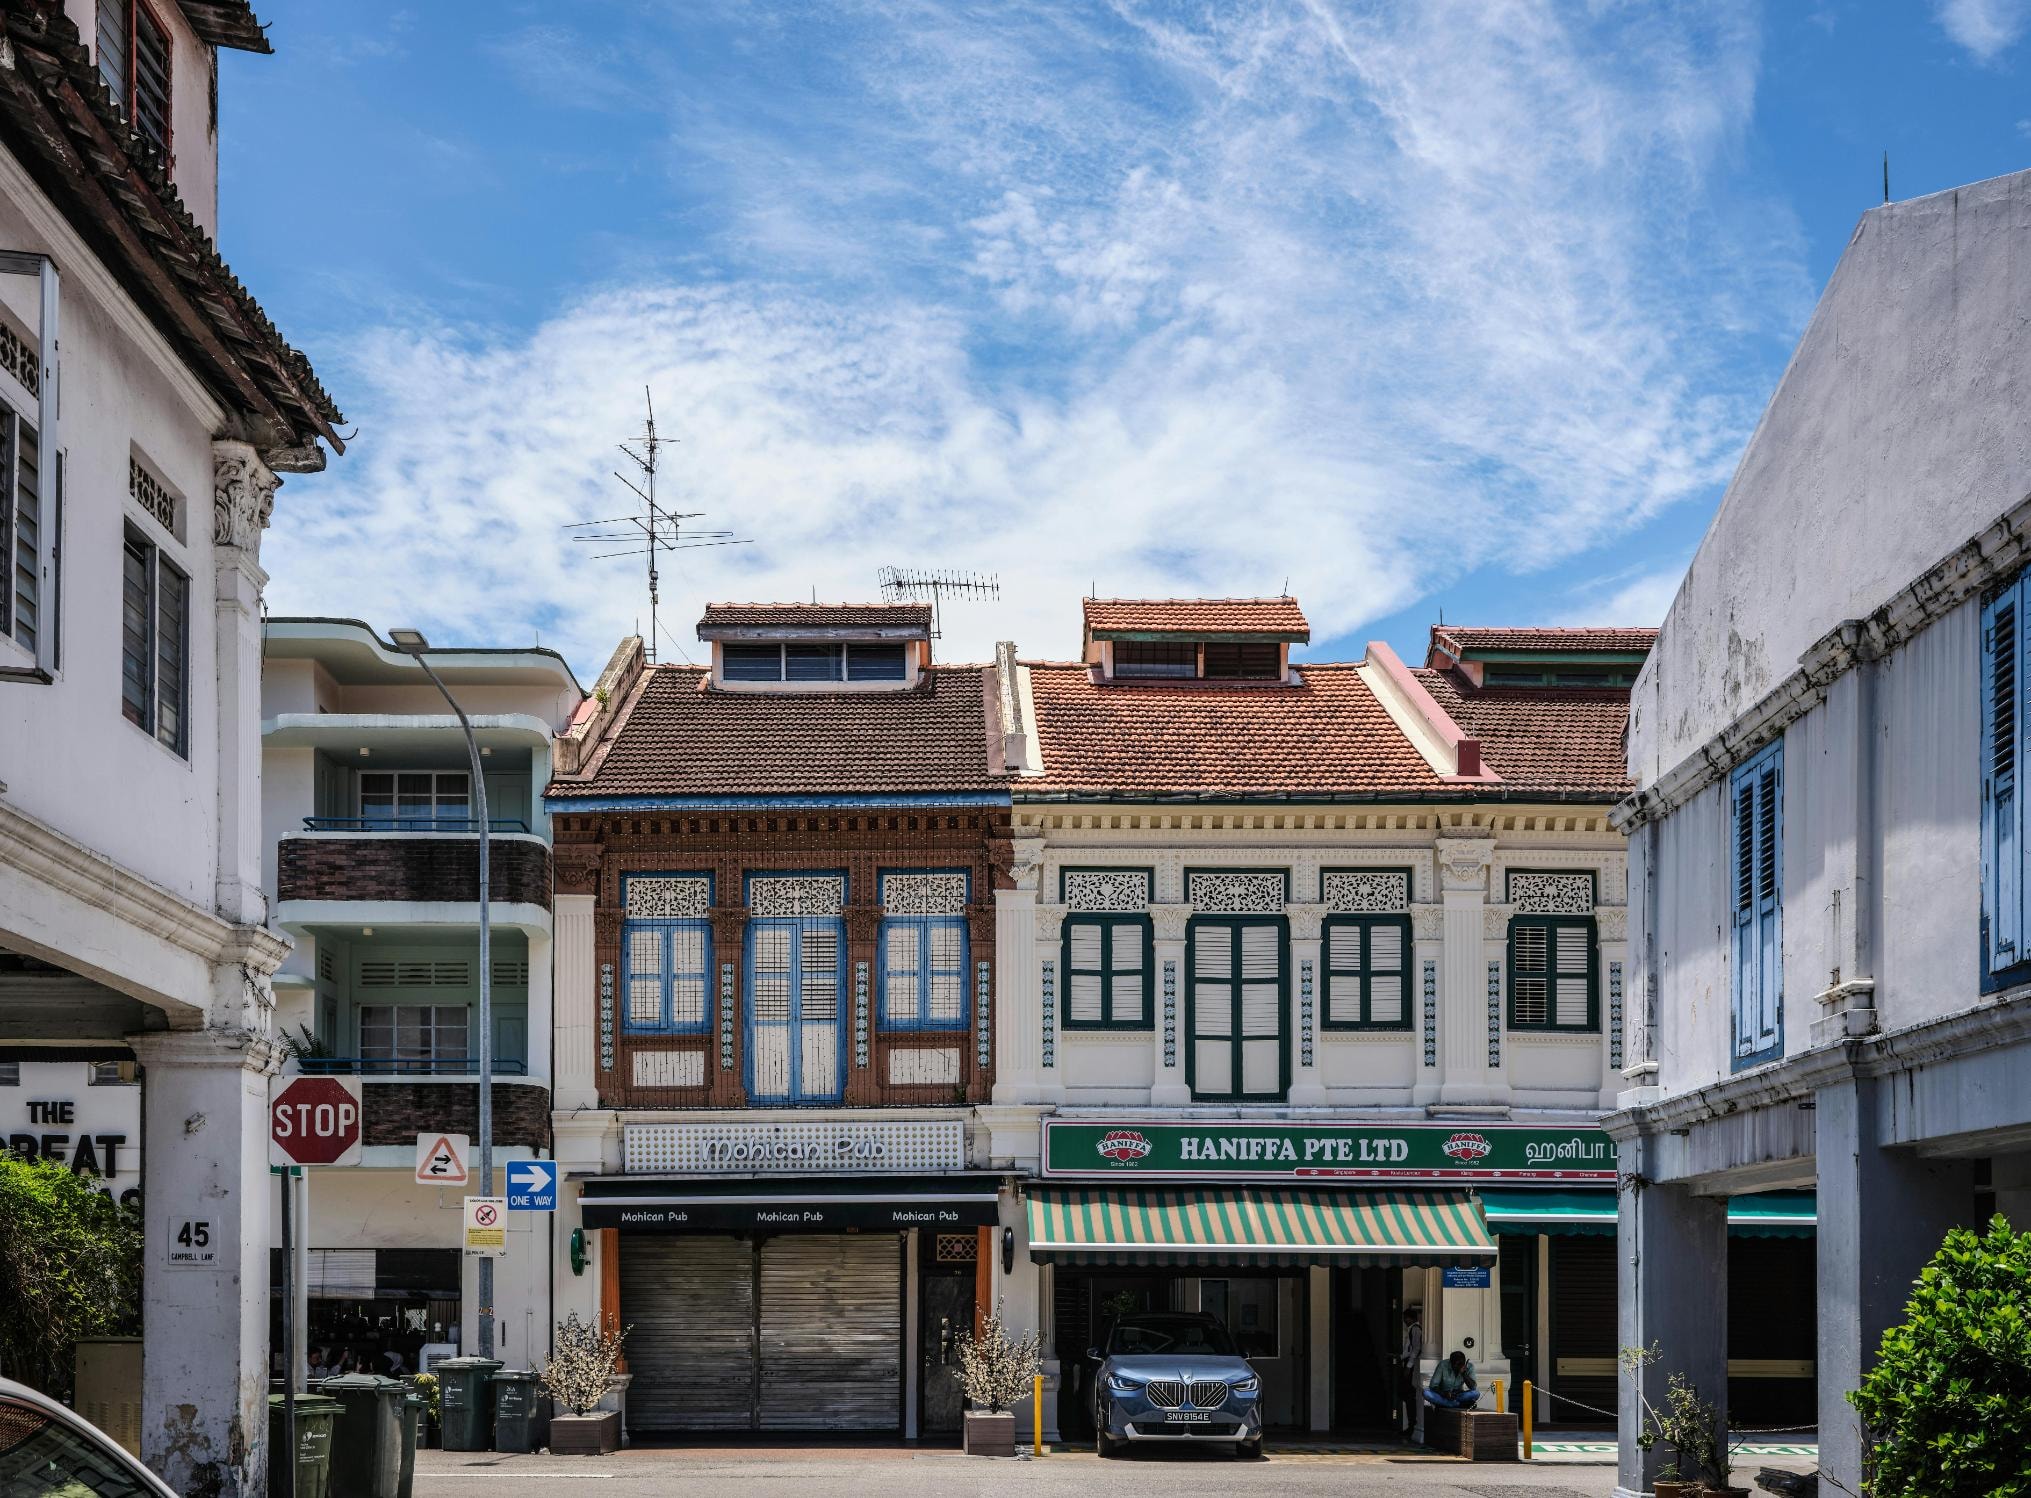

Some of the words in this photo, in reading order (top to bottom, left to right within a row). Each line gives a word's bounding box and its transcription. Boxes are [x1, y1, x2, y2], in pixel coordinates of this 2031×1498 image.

[26, 1101, 75, 1124] THE
[275, 1103, 356, 1137] STOP
[702, 1136, 821, 1161] Mohican
[835, 1136, 886, 1159] Pub
[1102, 1139, 1147, 1151] HANIFFA
[1180, 1137, 1298, 1161] HANIFFA
[1303, 1138, 1354, 1161] PTE
[1358, 1138, 1409, 1162] LTD
[1447, 1140, 1487, 1152] HANIFFA
[0, 1134, 127, 1178] REAT
[1525, 1137, 1605, 1166] ஹனிபா
[510, 1195, 530, 1206] ONE
[533, 1195, 553, 1206] WAY
[621, 1211, 664, 1222] Mohican
[668, 1211, 688, 1221] Pub
[756, 1211, 800, 1222] Mohican
[803, 1211, 823, 1221] Pub
[892, 1211, 935, 1221] Mohican
[939, 1210, 959, 1221] Pub
[178, 1221, 209, 1247] 45
[171, 1252, 198, 1261] CAMPBELL
[1167, 1412, 1210, 1421] SNV8154E
